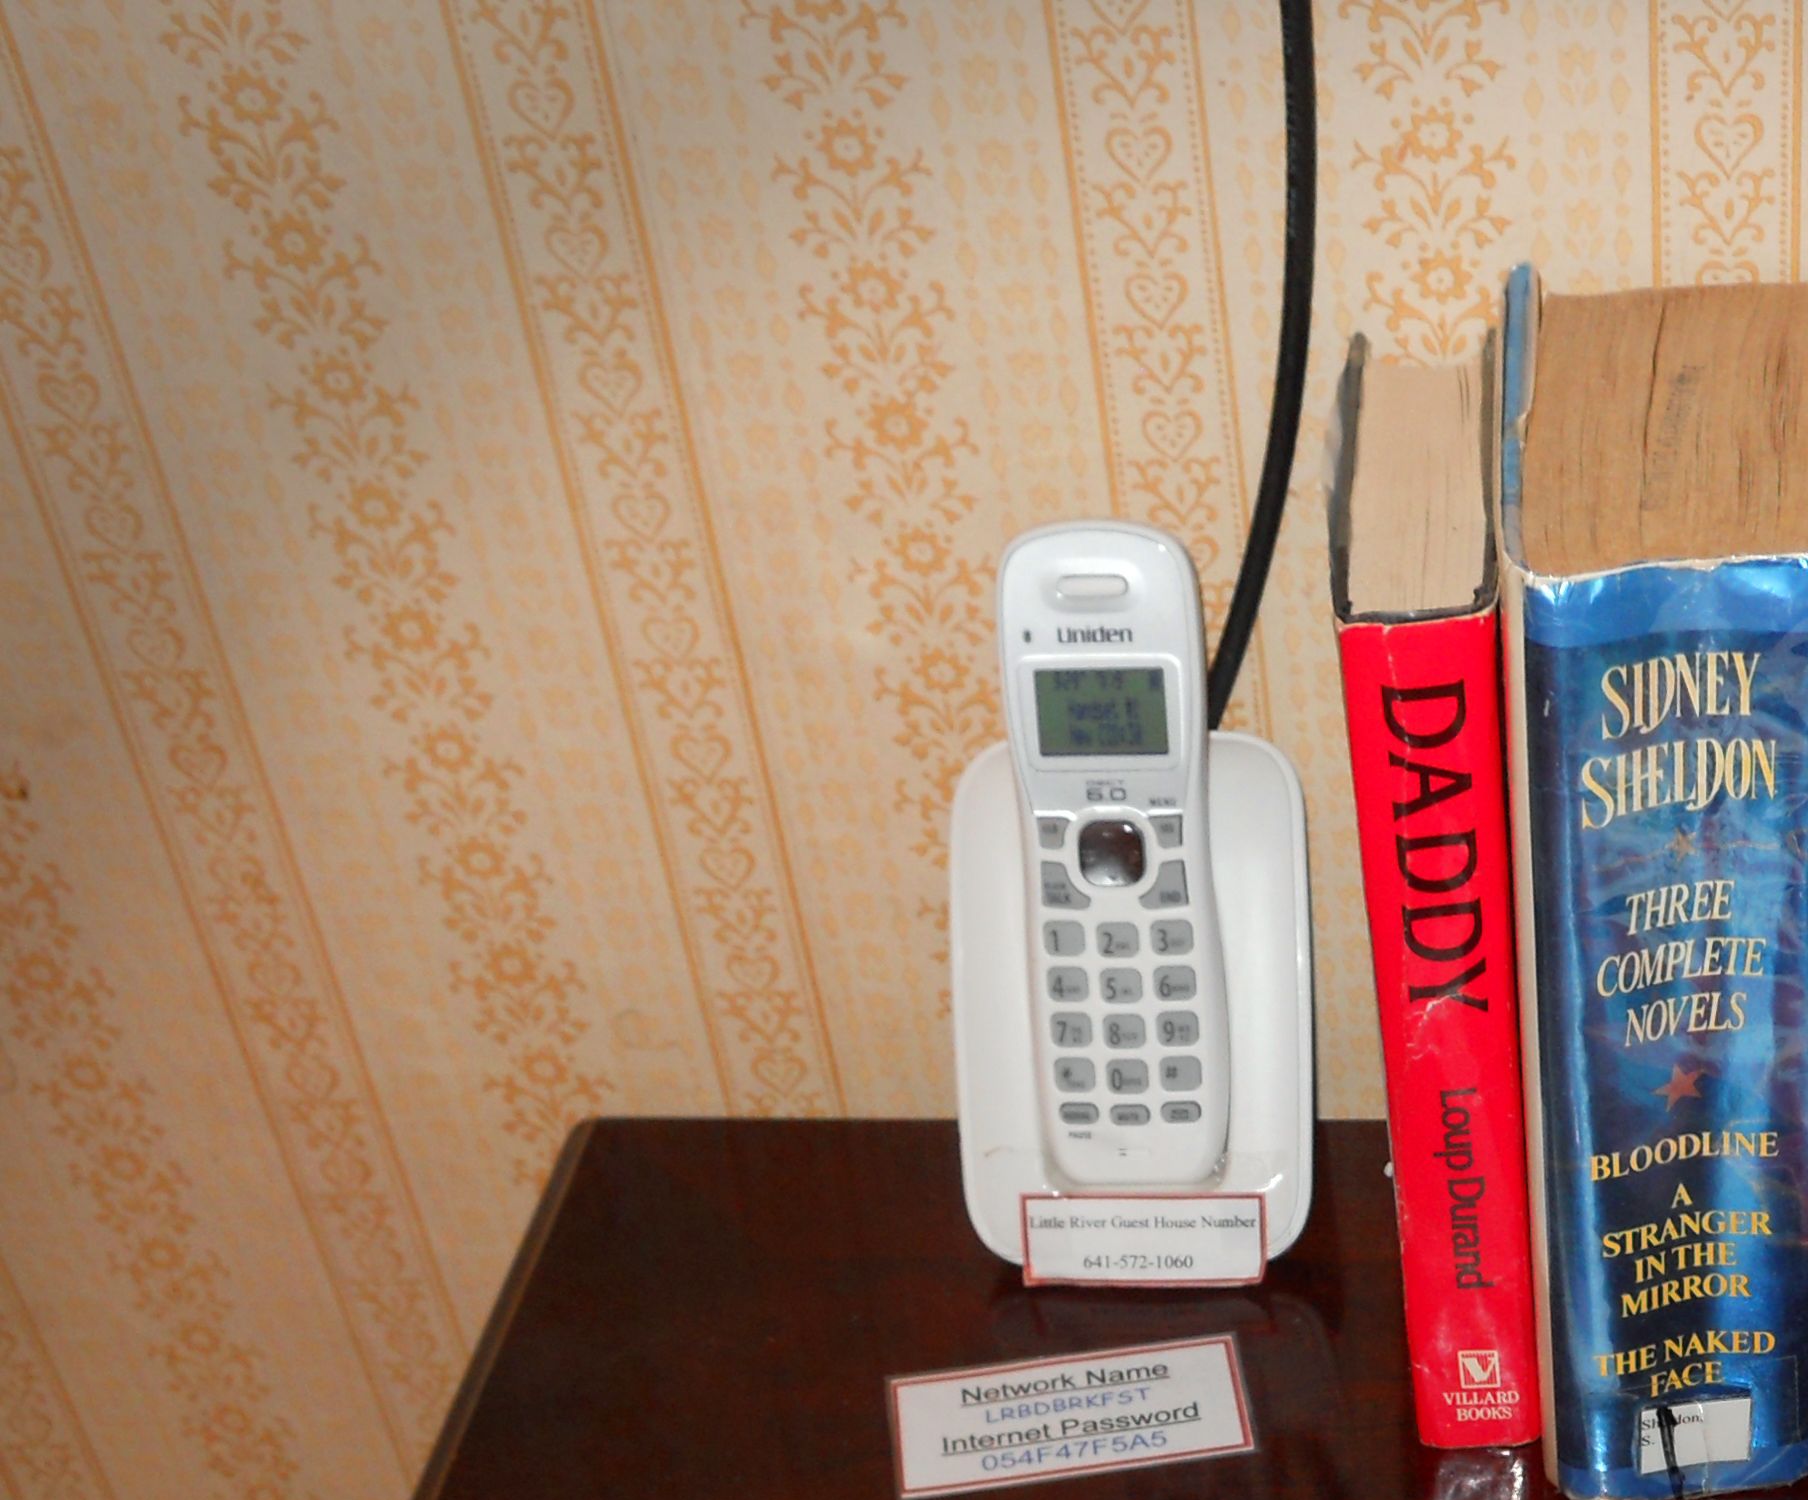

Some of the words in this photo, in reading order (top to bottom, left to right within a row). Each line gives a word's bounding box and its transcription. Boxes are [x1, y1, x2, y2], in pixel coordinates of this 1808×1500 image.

[1057, 627, 1133, 644] Uniden
[1601, 651, 1760, 741] SIDNEY
[1581, 739, 1778, 829] SHELDON
[1380, 679, 1488, 1014] DADDY
[1626, 881, 1735, 937] THREE
[1596, 937, 1766, 1000] COMPLETE
[1624, 991, 1746, 1049] NOVELS
[1433, 1088, 1477, 1171] Loup
[1589, 1131, 1779, 1183] BLOODLINE
[1671, 1183, 1693, 1209] A
[1029, 1214, 1066, 1230] Little
[1069, 1216, 1106, 1228] River
[1110, 1215, 1149, 1228] Guest
[1153, 1215, 1196, 1229] House
[1201, 1213, 1257, 1230] Number
[1447, 1177, 1494, 1290] Durand
[1601, 1210, 1773, 1260] STRANGER
[1082, 1254, 1194, 1269] 641-572-1060
[1634, 1249, 1668, 1284] IN
[1673, 1239, 1737, 1273] THE
[1620, 1273, 1751, 1319] MIRROR
[1596, 1350, 1657, 1382] THE
[1660, 1331, 1777, 1366] NAKED
[1650, 1361, 1724, 1398] FACE
[960, 1372, 1077, 1402] Network
[1084, 1363, 1168, 1387] Name
[985, 1386, 1150, 1423] LRBDBRKFST
[1443, 1390, 1520, 1406] VILLARD
[941, 1423, 1051, 1451] Internet
[1059, 1400, 1200, 1435] Password
[1456, 1406, 1513, 1422] BOOKS
[980, 1430, 1167, 1471] 054F47F5A5
